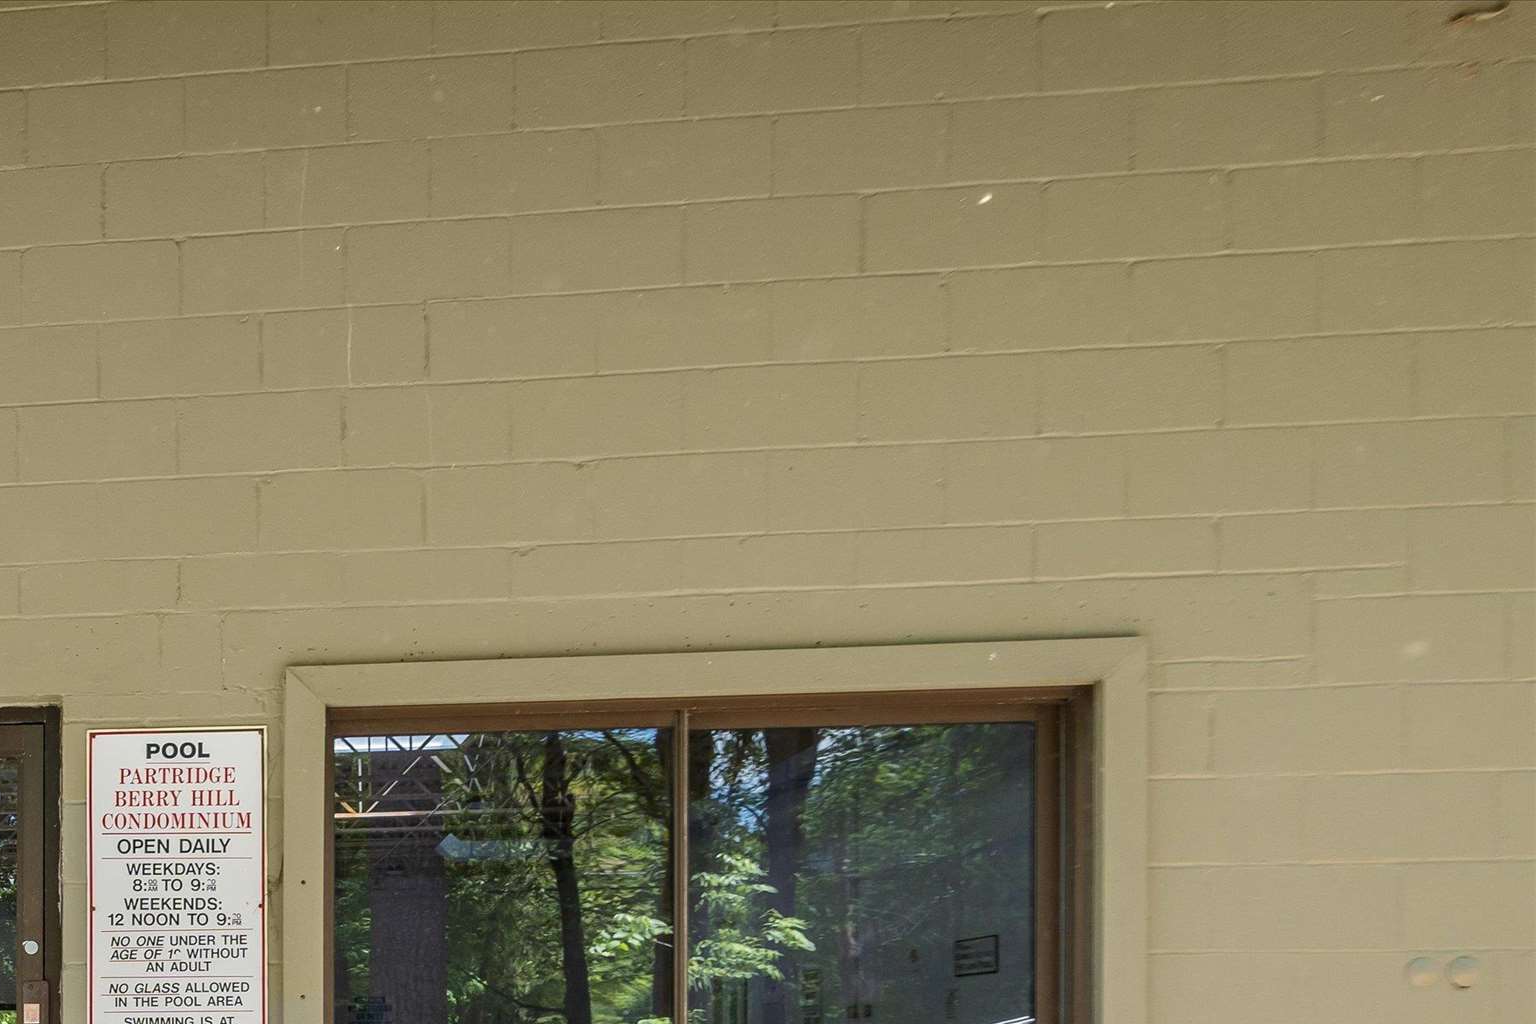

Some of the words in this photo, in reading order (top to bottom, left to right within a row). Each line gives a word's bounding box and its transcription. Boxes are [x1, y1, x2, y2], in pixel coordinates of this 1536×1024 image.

[146, 742, 211, 759] POOL
[119, 767, 236, 784] PARTRIDGE
[114, 791, 182, 807] BERRY
[191, 790, 240, 806] HILL
[102, 812, 252, 829] CONDOMINIUM
[117, 839, 169, 854] OPEN
[179, 839, 230, 853] DAILY
[126, 863, 220, 875] WEEKDAYS:
[162, 879, 182, 891] TO
[124, 897, 223, 910] WEEKENDS:
[108, 914, 124, 926] 12
[132, 914, 179, 925] NOON
[188, 914, 208, 925] TO
[111, 937, 130, 946] NO
[137, 936, 164, 946] ONE
[170, 936, 215, 945] UNDER
[222, 935, 247, 944] THE
[110, 950, 137, 960] AGE
[144, 950, 163, 959] OF
[187, 948, 248, 958] WITHOUT
[146, 963, 164, 972] AN
[170, 962, 211, 971] ADULT
[109, 984, 128, 993] NO
[135, 983, 180, 993] GLASS
[185, 982, 250, 992] ALLOWED
[115, 997, 127, 1007] IN
[134, 997, 158, 1007] THE
[165, 997, 201, 1006] POOL
[208, 996, 243, 1006] AREA
